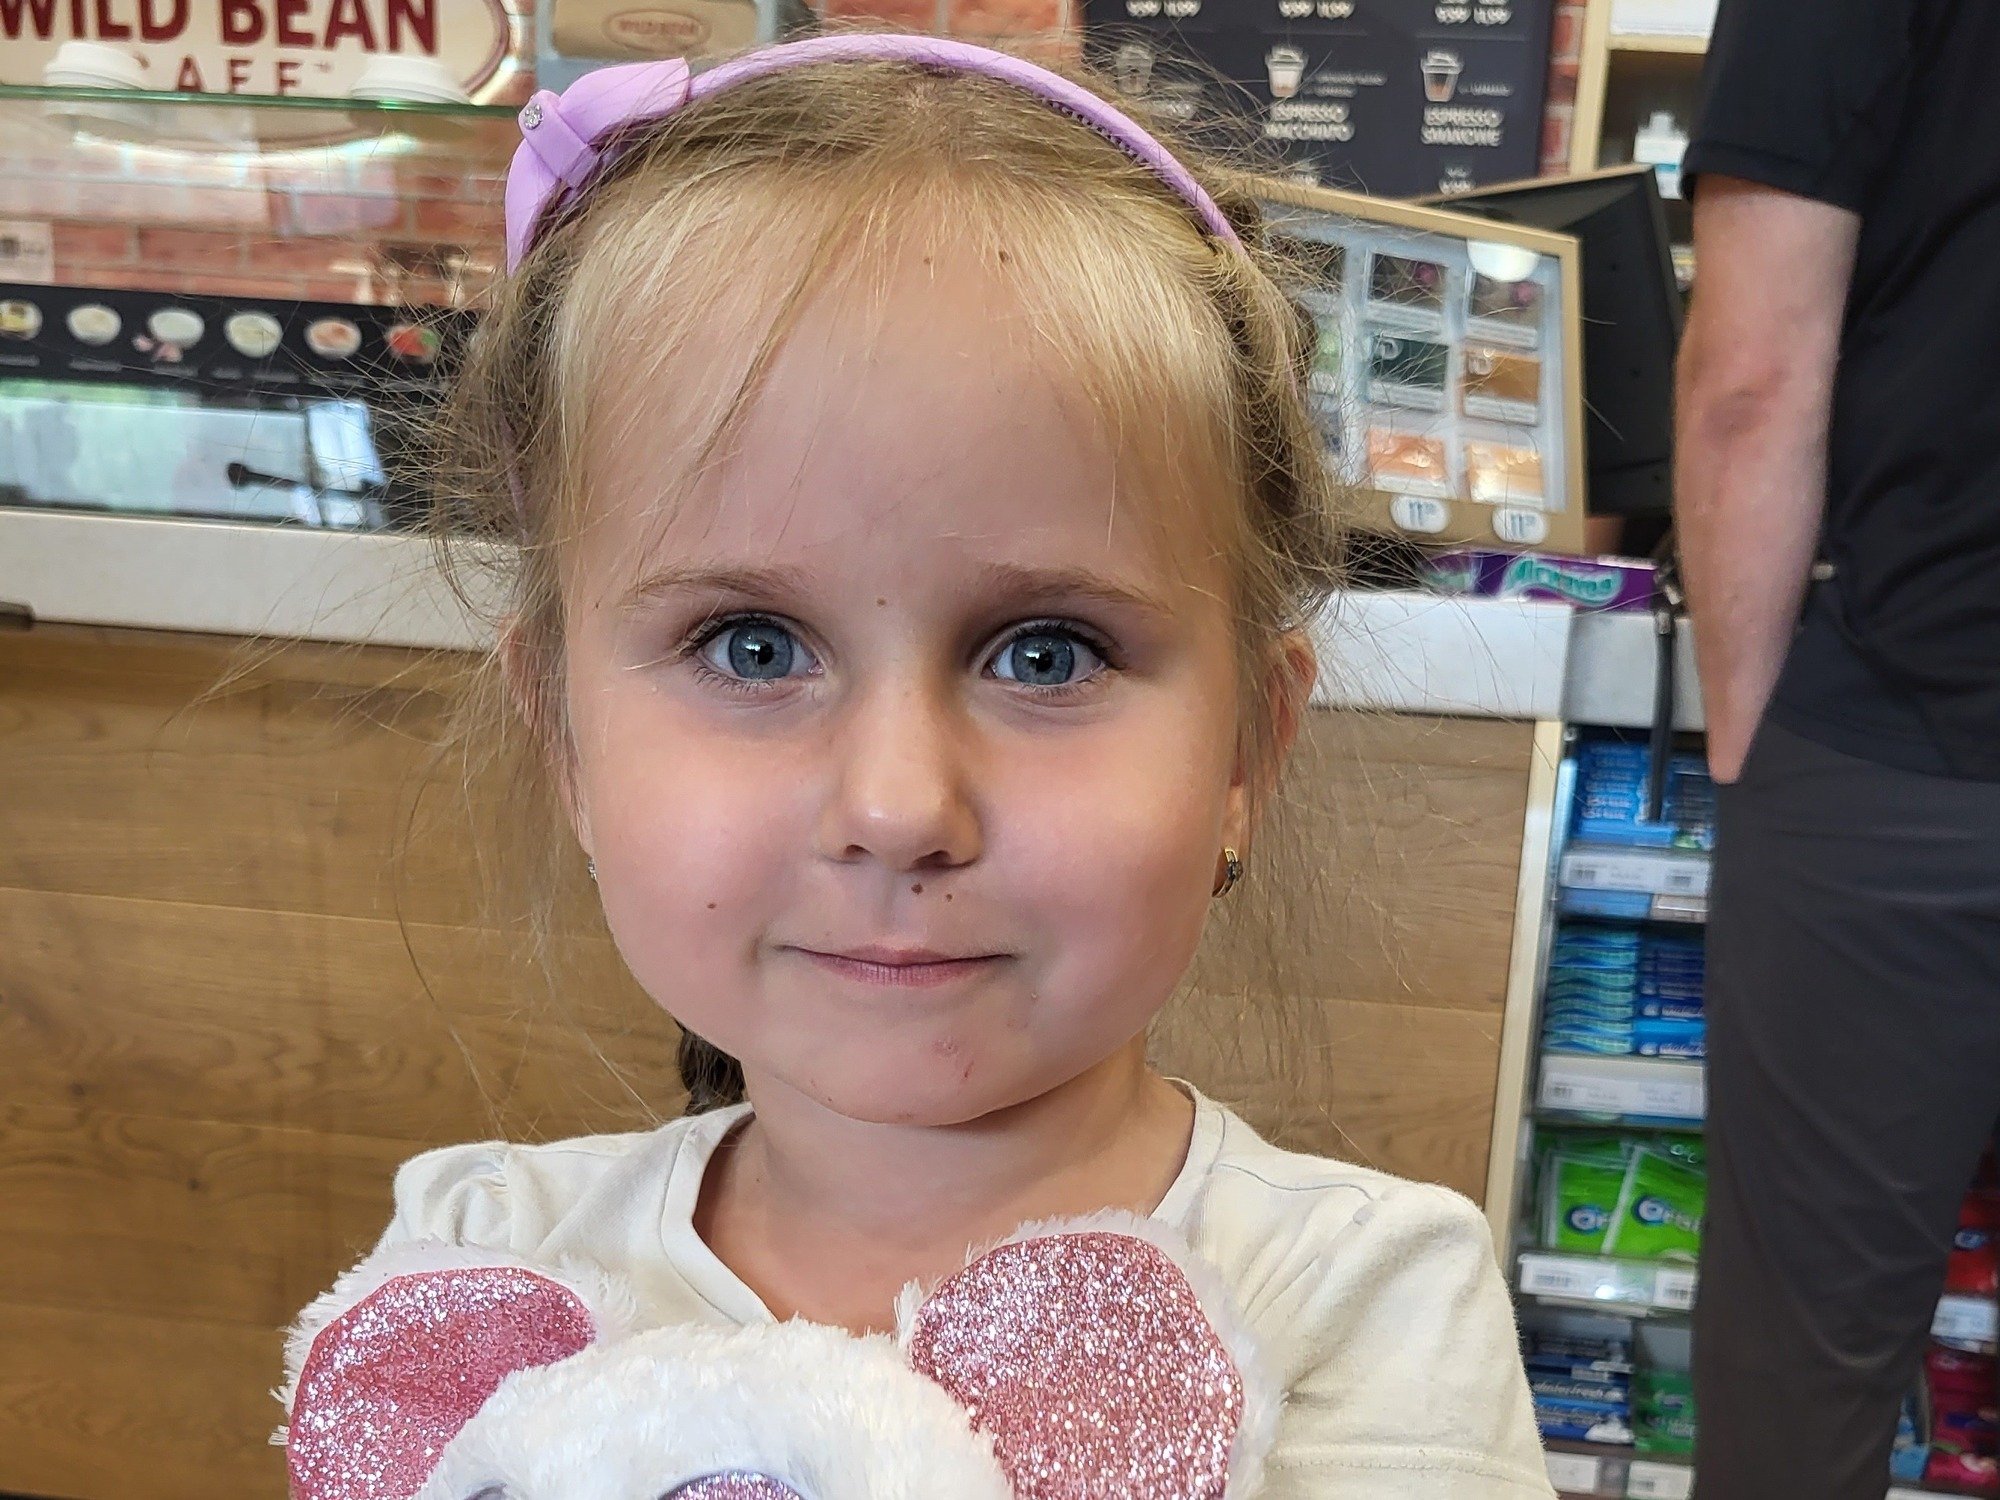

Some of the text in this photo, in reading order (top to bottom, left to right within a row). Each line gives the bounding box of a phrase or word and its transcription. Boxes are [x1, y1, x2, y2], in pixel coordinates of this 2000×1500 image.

[1, 0, 440, 55] WILD BEAN
[1423, 107, 1503, 127] ESPRESSO
